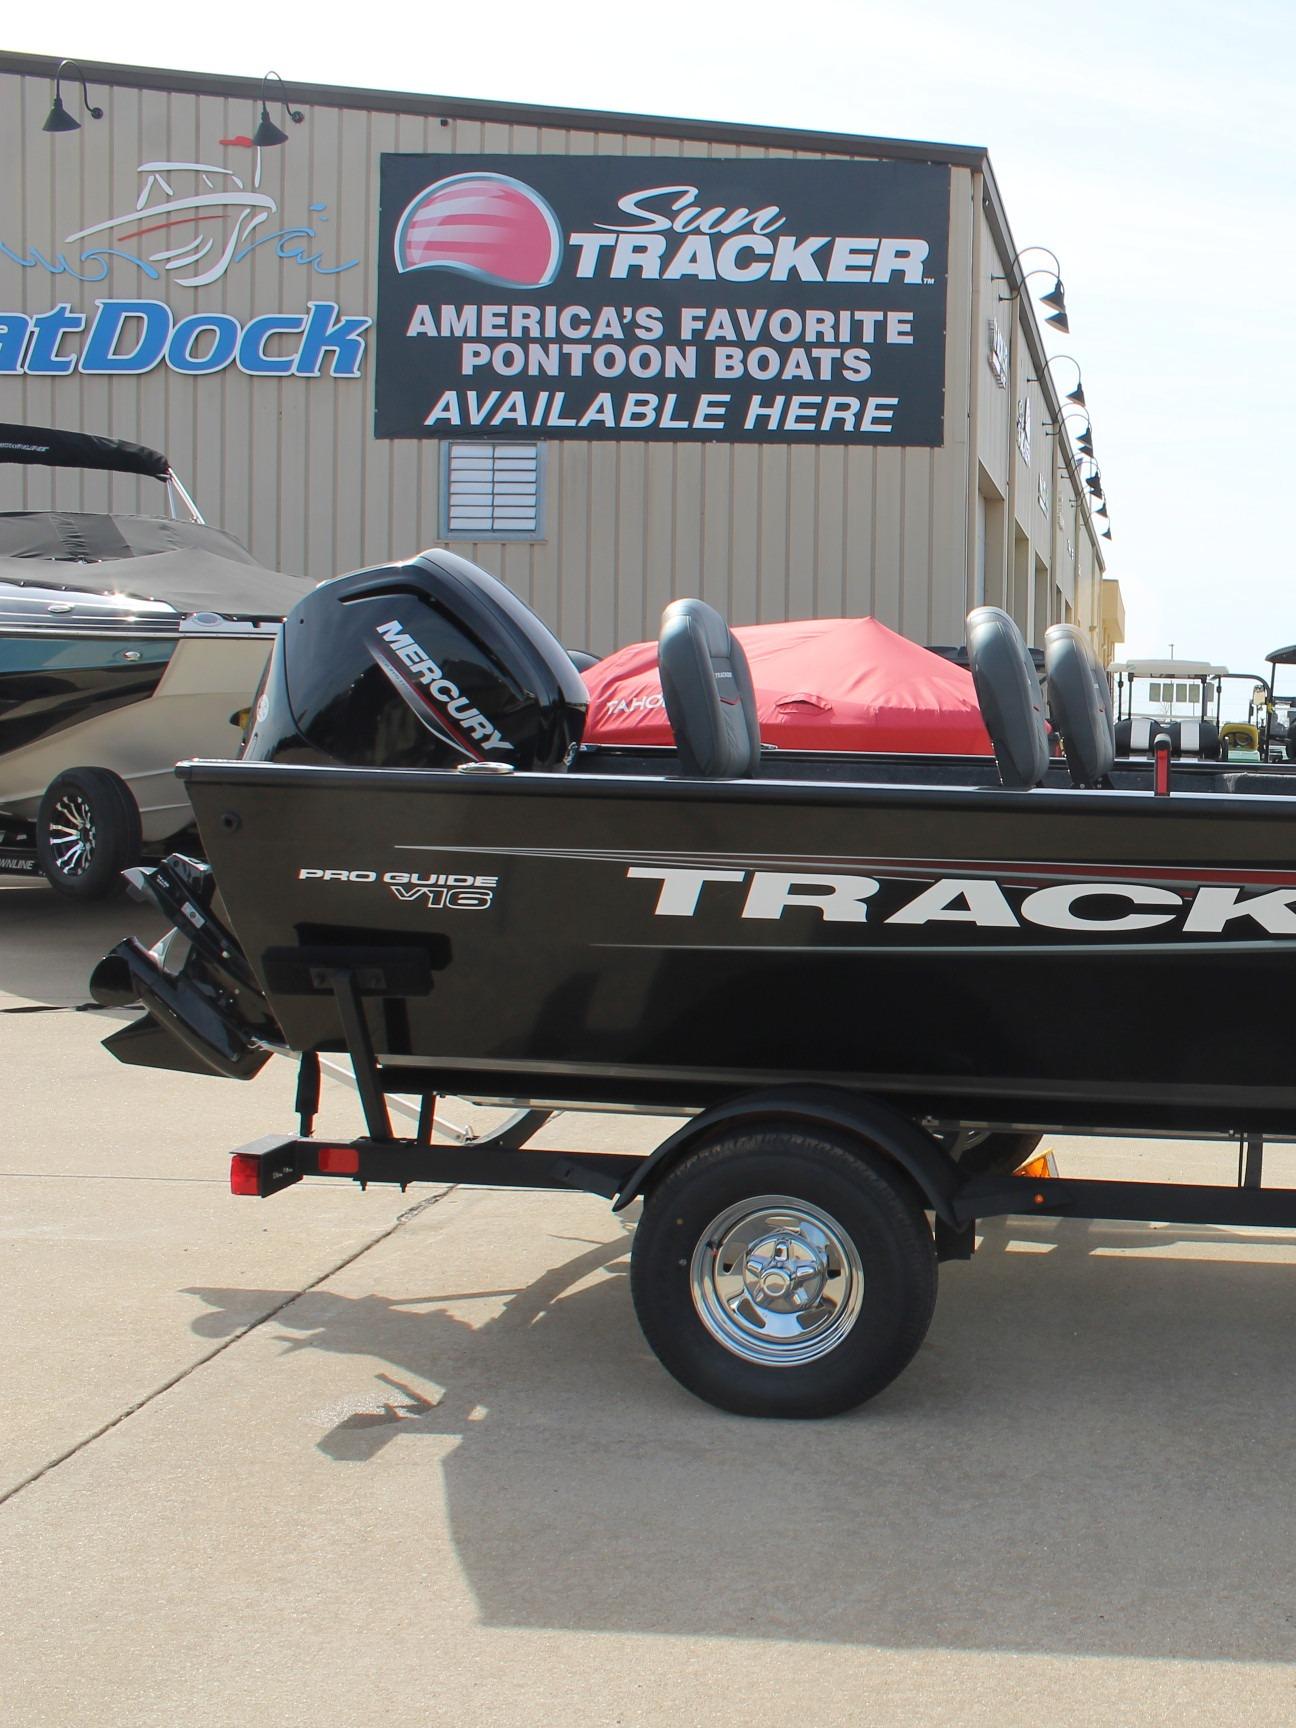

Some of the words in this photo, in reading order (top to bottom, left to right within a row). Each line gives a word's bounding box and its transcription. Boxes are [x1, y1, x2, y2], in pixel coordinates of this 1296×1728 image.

[594, 185, 786, 234] Sun
[568, 232, 930, 285] TRACKER
[406, 304, 663, 341] AMERICA'S
[681, 307, 914, 345] FAVORITE
[461, 342, 698, 379] PONTOON
[715, 346, 873, 383] BOATS
[423, 390, 731, 430] AVAILABLE
[743, 394, 900, 433] HERE
[376, 620, 514, 750] MERCURY
[607, 694, 665, 715] TAHO
[299, 868, 378, 883] PRO
[383, 872, 499, 888] GUIDE
[389, 885, 494, 910] V16
